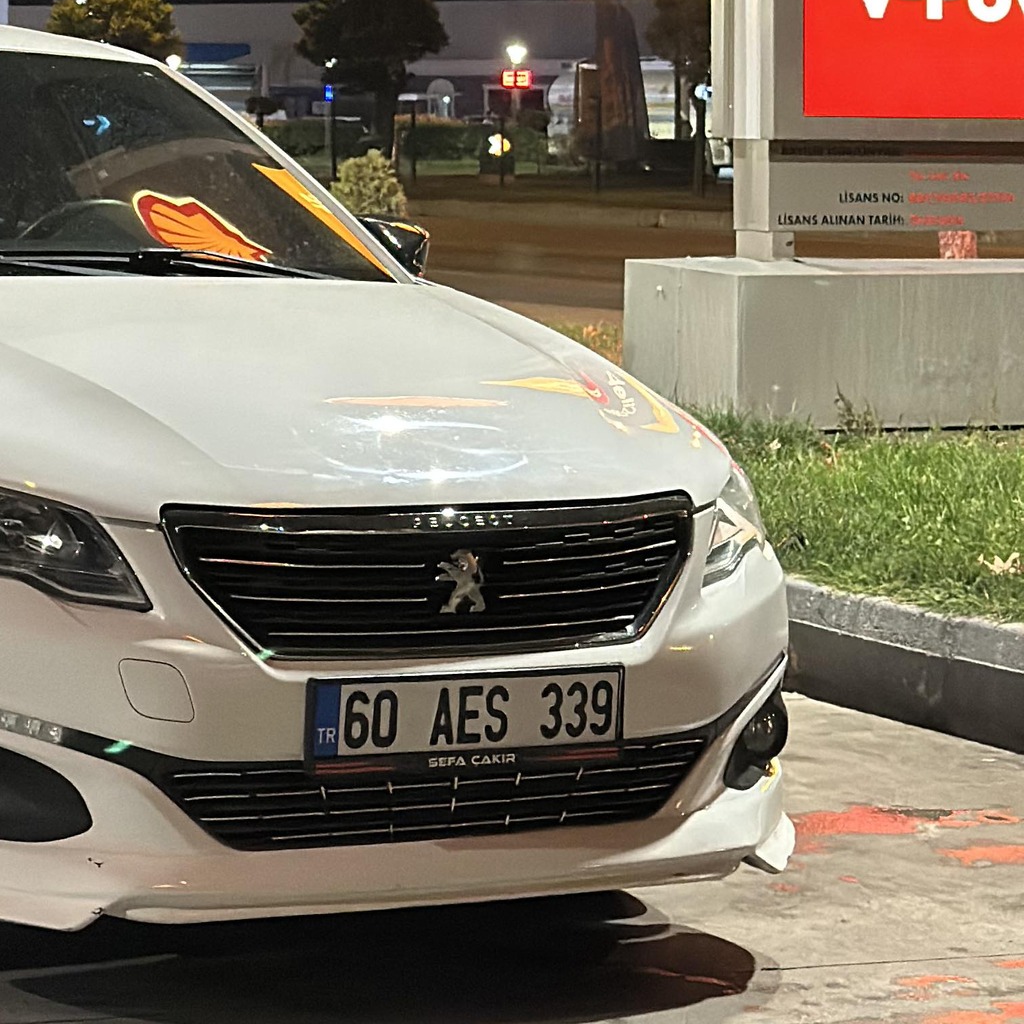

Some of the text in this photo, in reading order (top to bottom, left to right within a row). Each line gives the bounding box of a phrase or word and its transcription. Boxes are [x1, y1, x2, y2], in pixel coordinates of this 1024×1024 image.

[882, 192, 904, 203] NO:
[821, 215, 866, 226] ALINAN
[344, 680, 613, 749] 60 AES 339
[317, 727, 336, 744] TR
[428, 756, 466, 768] SEFA
